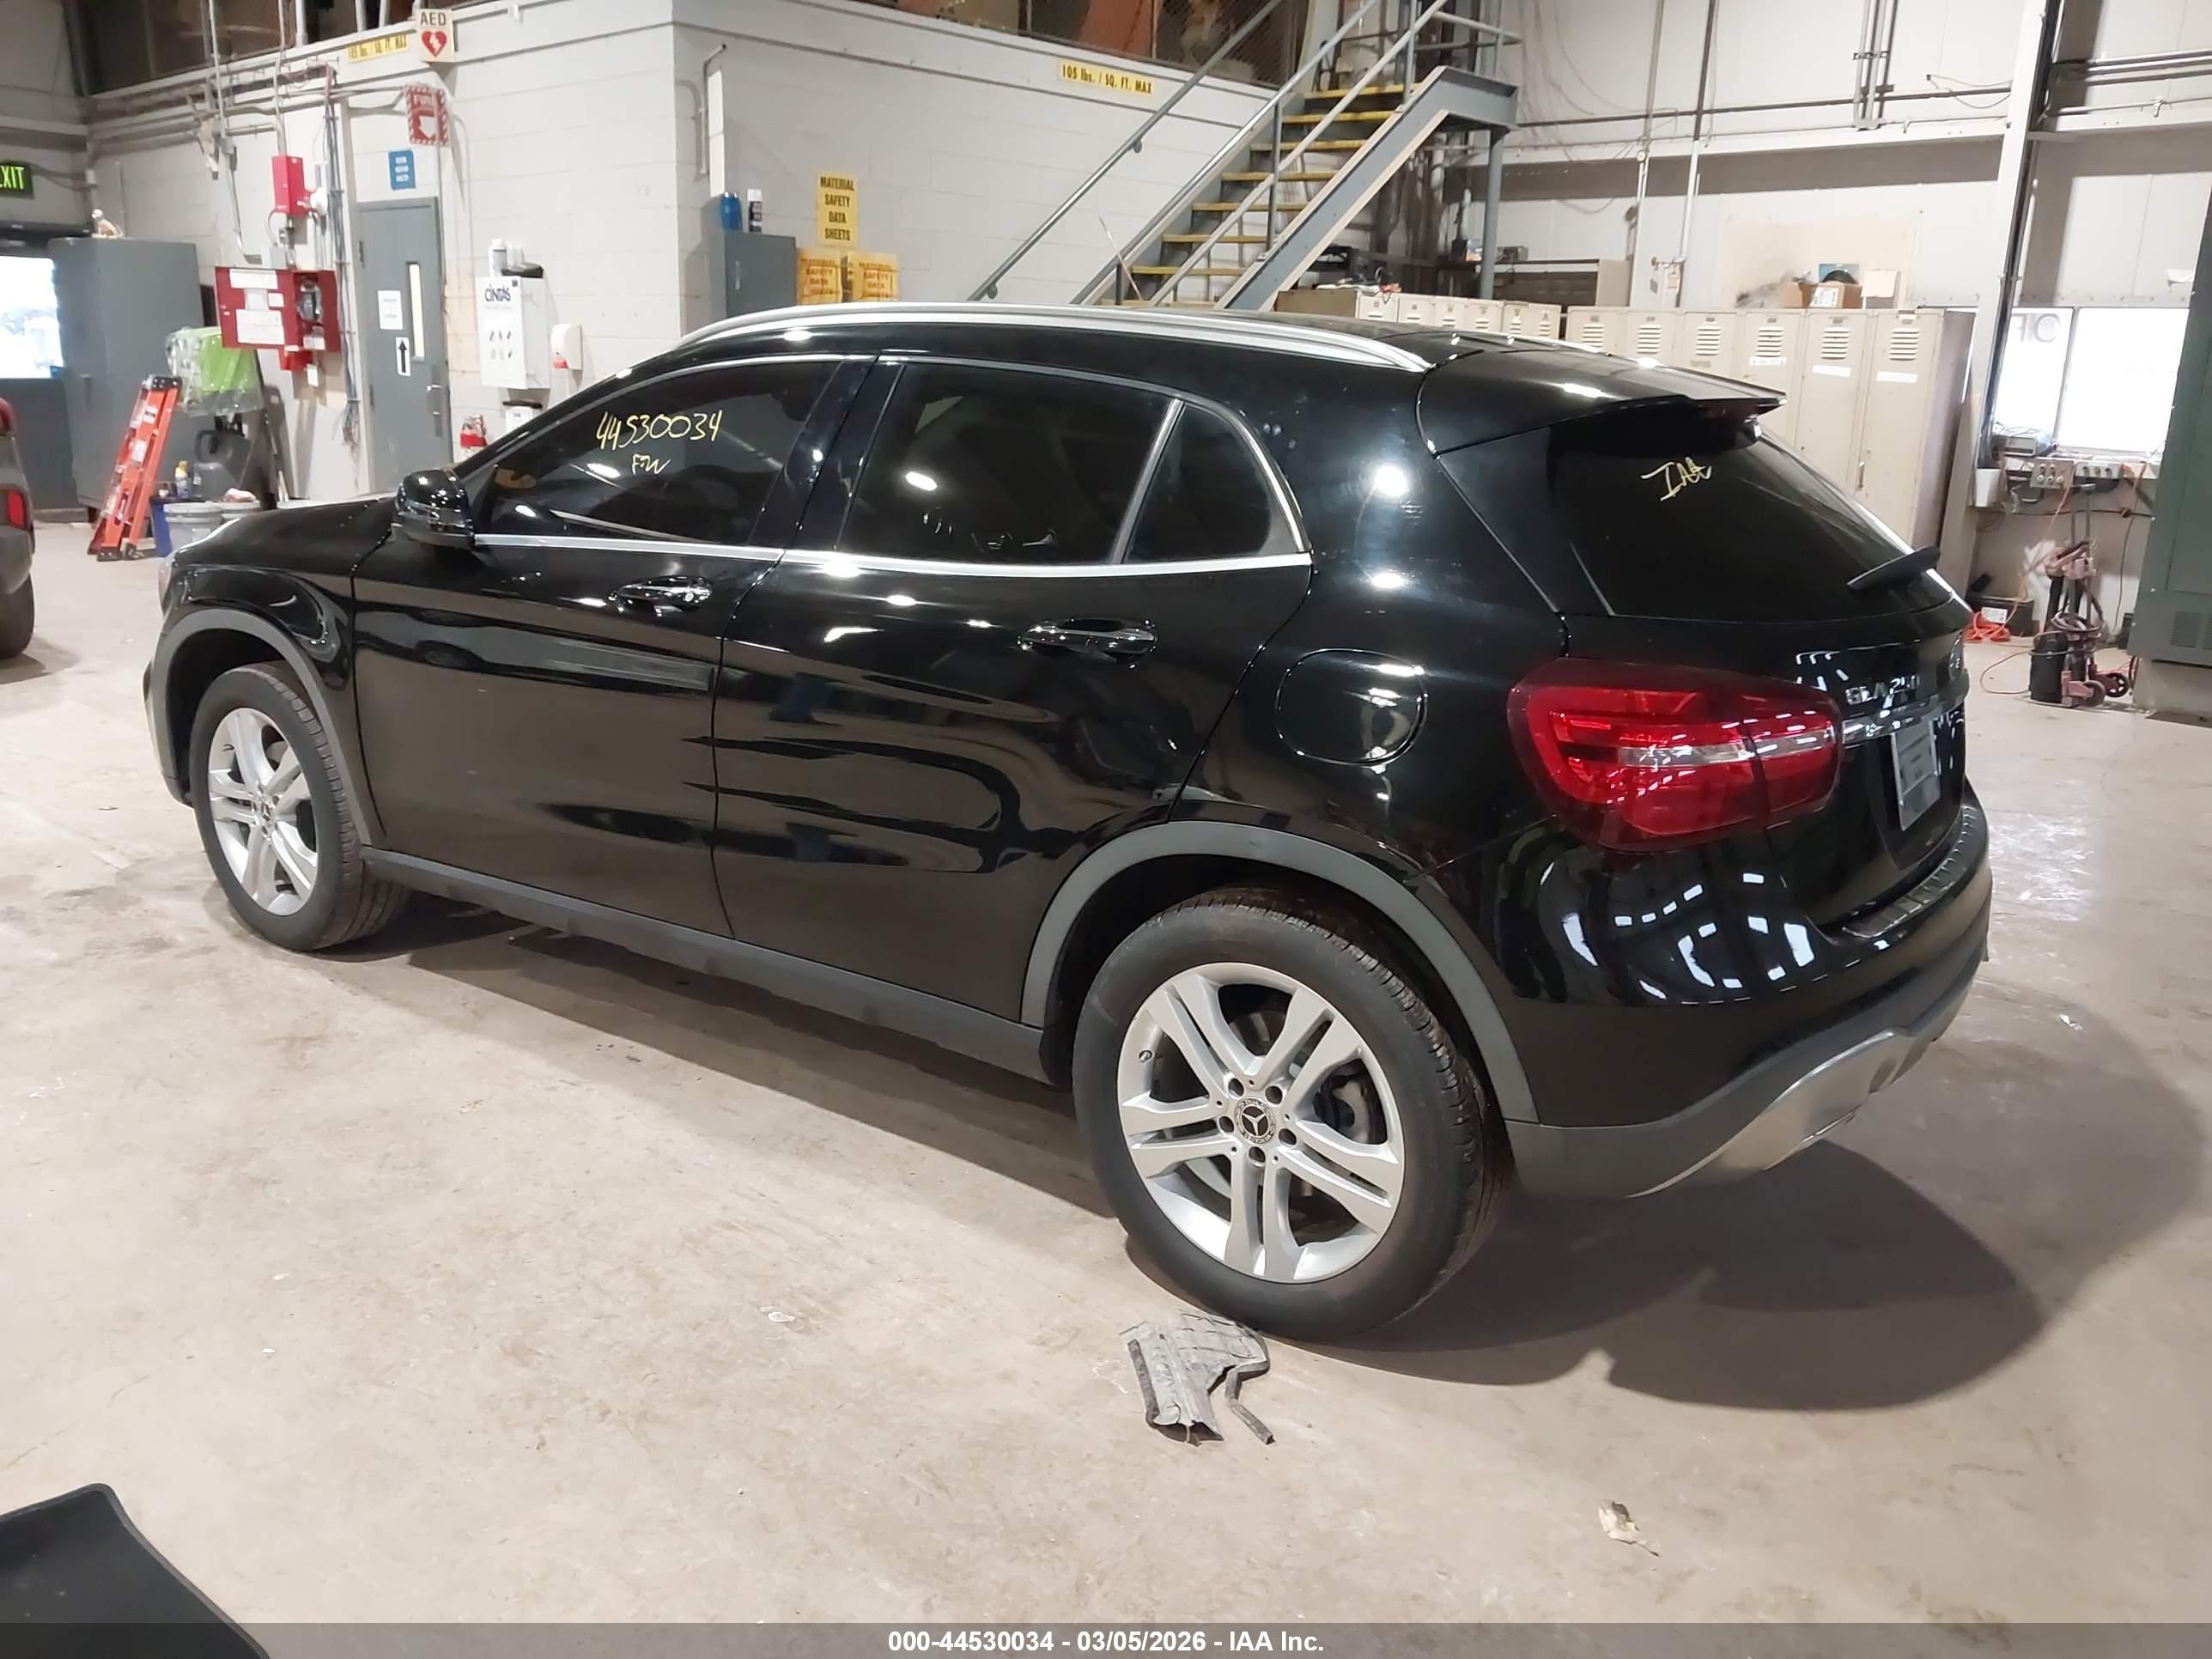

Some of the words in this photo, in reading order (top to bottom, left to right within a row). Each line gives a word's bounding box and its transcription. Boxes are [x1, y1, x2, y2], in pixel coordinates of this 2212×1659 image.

[420, 12, 447, 26] AED
[1062, 64, 1078, 80] 105
[1134, 80, 1152, 94] MAX
[0, 165, 24, 190] XIT
[820, 176, 854, 191] MATERIAL
[824, 193, 850, 208] SAFETY
[829, 210, 846, 224] DATA
[824, 228, 850, 241] SHEETS
[596, 410, 723, 450] 44530034
